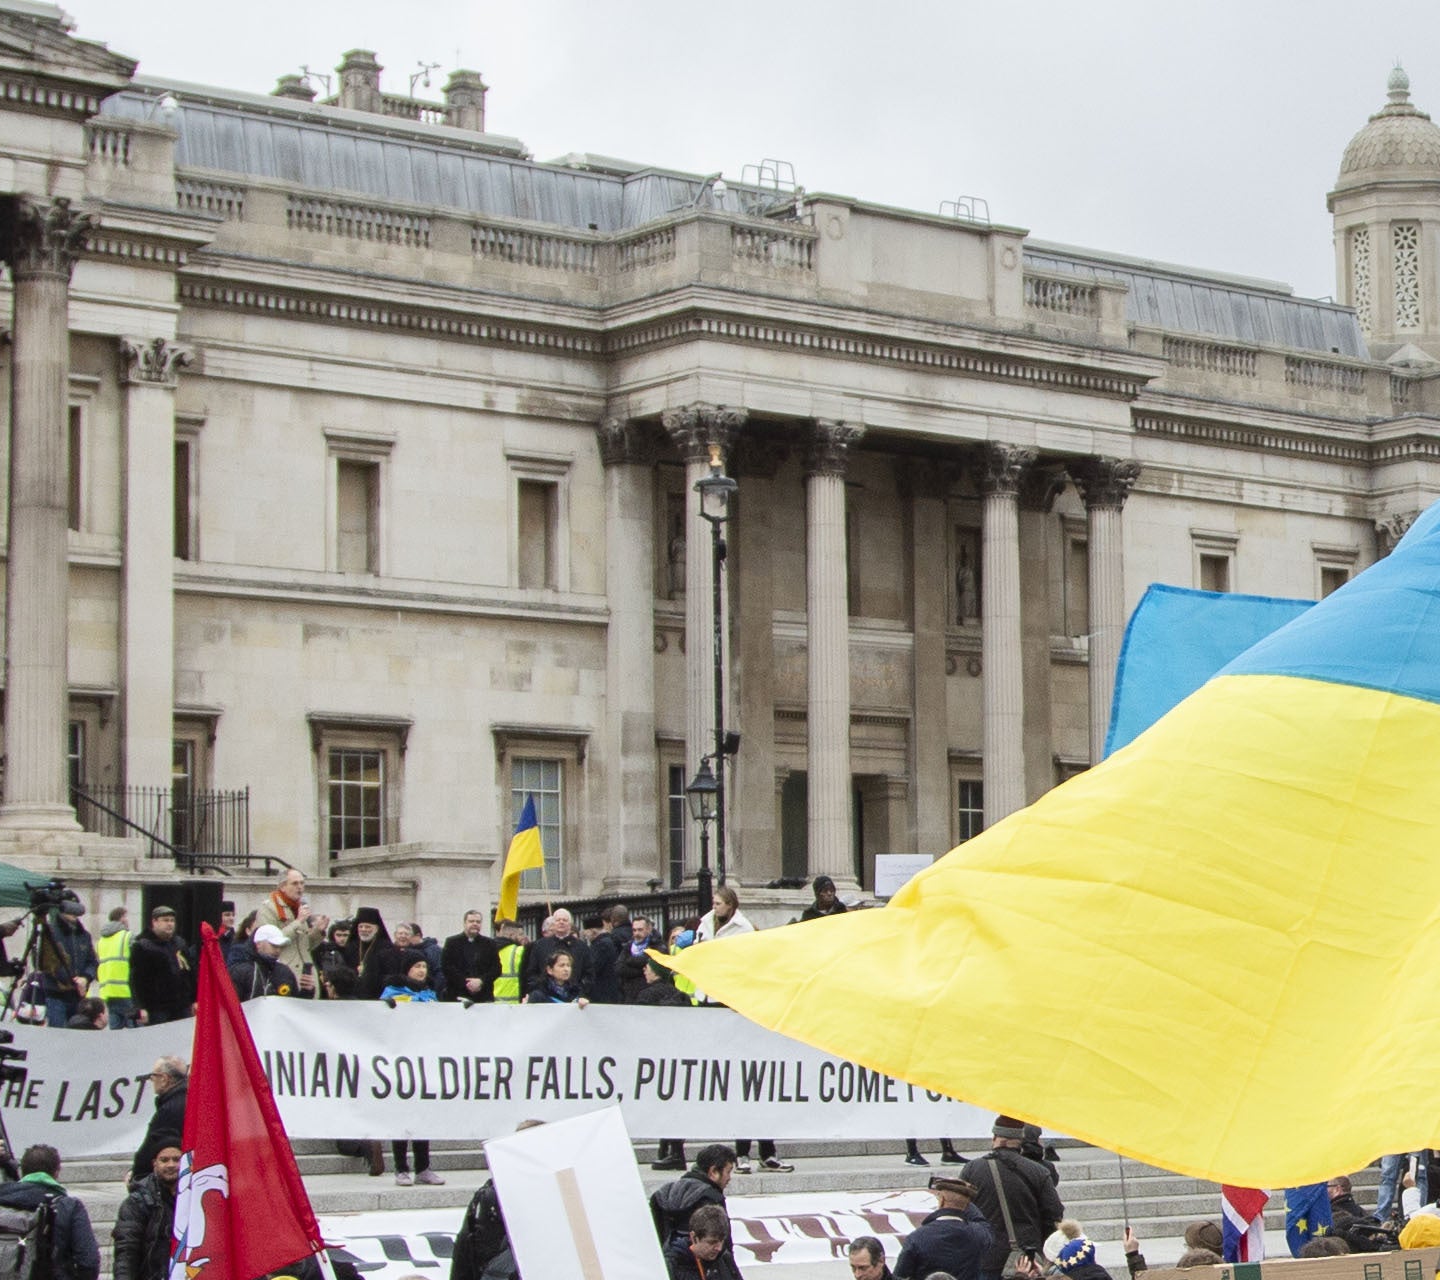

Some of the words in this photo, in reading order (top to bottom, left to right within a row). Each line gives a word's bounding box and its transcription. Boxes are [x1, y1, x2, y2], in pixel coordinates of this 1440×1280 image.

[3, 1079, 44, 1110] HE
[52, 1074, 153, 1122] LAST
[371, 1055, 514, 1100] SOLDIER
[525, 1056, 623, 1103] FALLS,
[634, 1057, 731, 1101] PUTIN
[739, 1059, 809, 1102] WILL
[818, 1061, 898, 1103] COME
